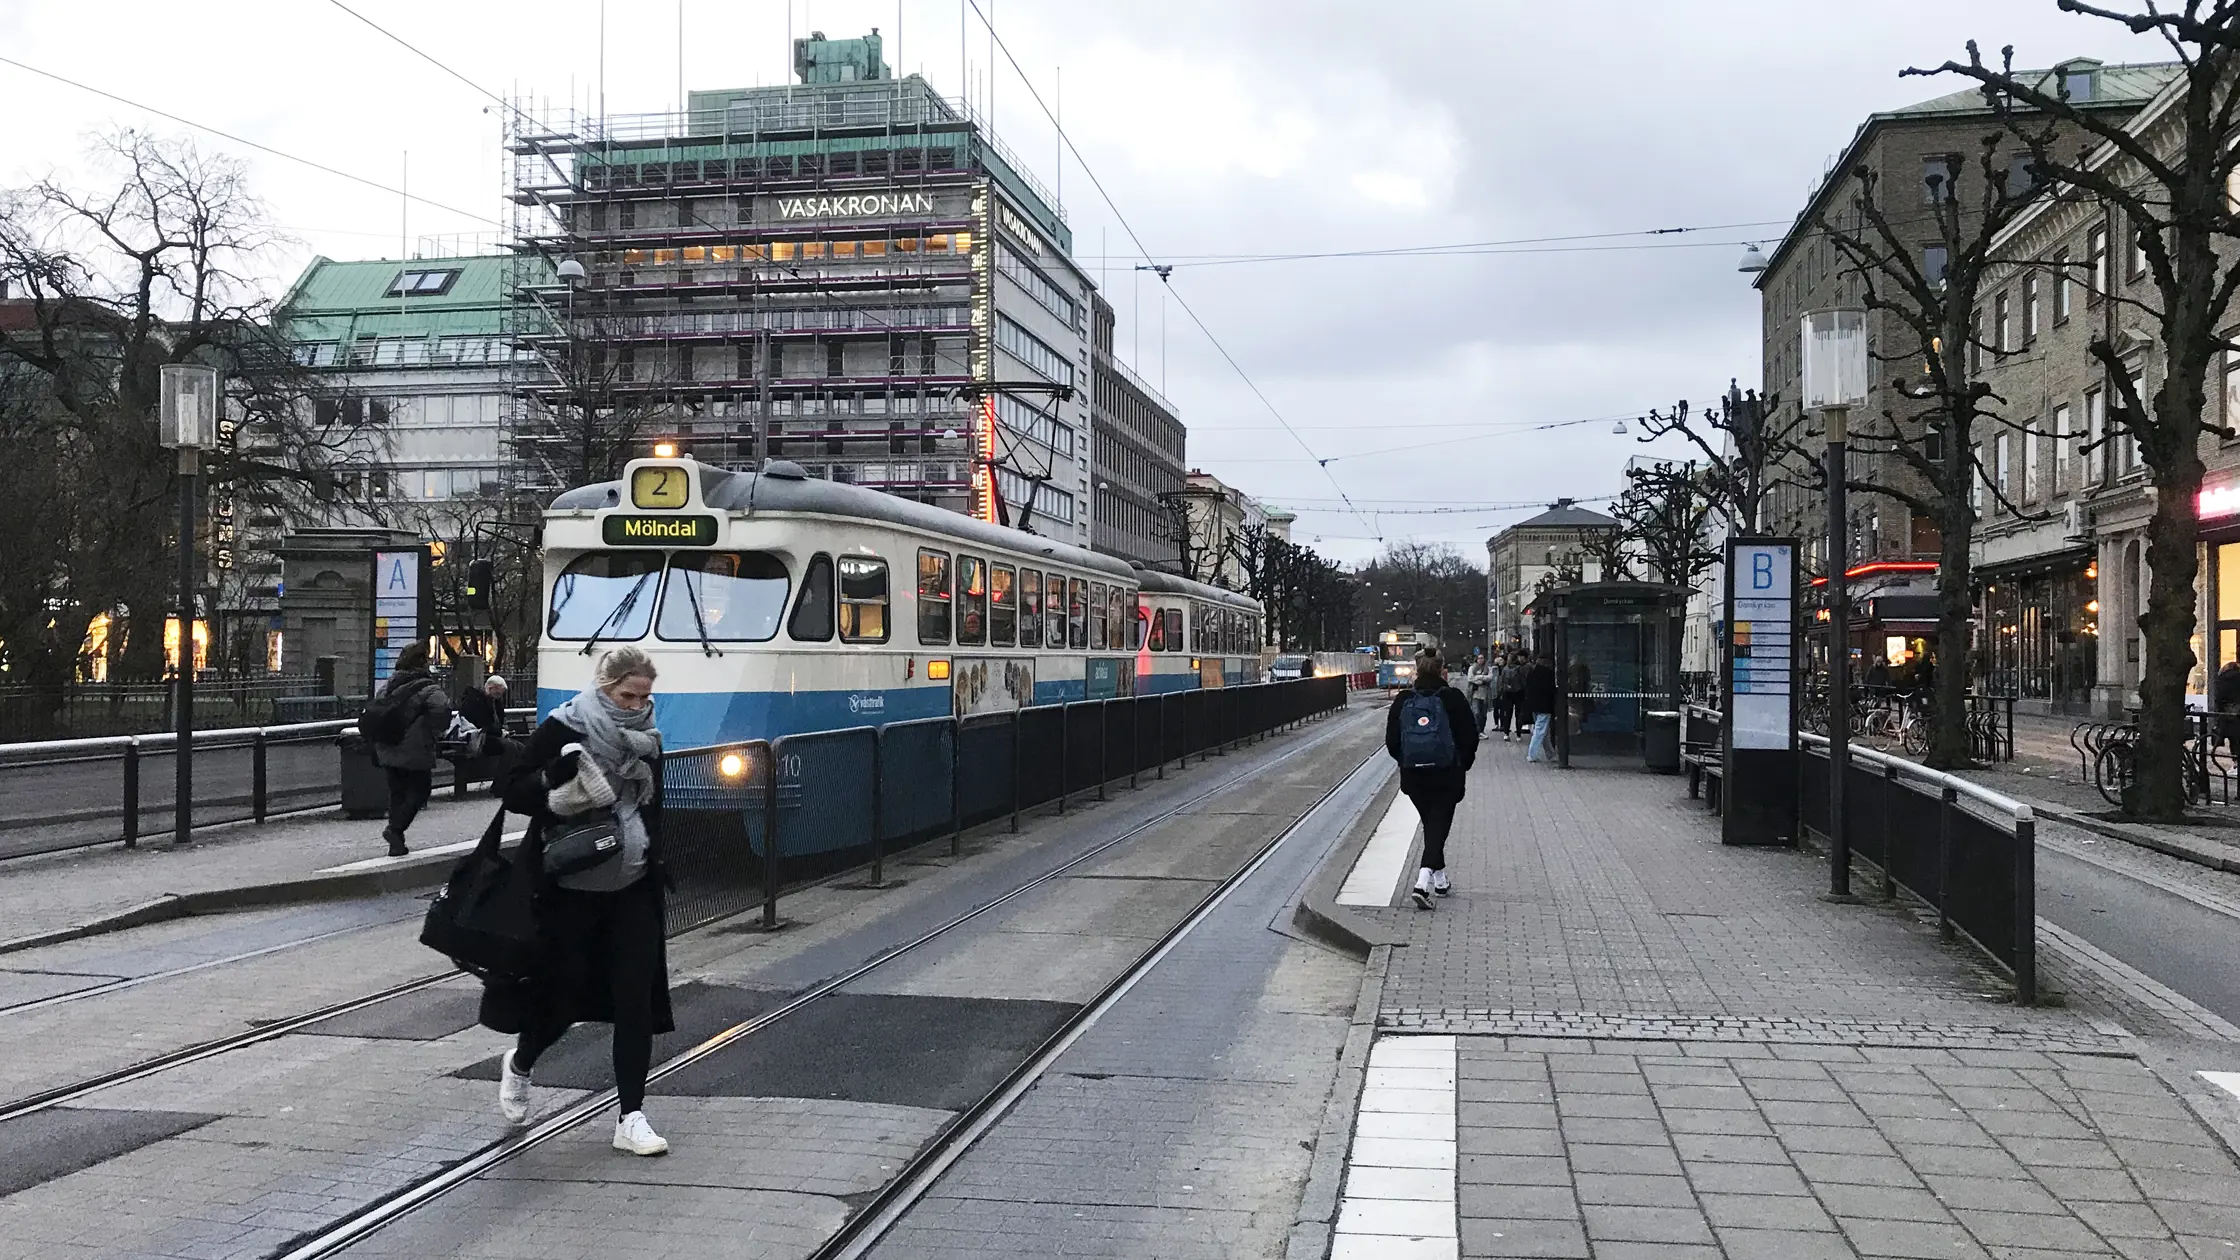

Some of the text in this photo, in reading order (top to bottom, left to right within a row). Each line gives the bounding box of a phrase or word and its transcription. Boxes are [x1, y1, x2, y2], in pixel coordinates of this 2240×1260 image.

[778, 193, 934, 218] VASAKRONAN
[971, 199, 983, 212] 40
[1001, 204, 1042, 257] VASAKRONAN
[971, 253, 983, 268] 30
[971, 308, 983, 323] 20
[652, 469, 668, 496] 2
[971, 473, 983, 487] 10
[625, 519, 696, 537] Mölndal
[389, 558, 406, 590] A
[1753, 552, 1773, 589] B
